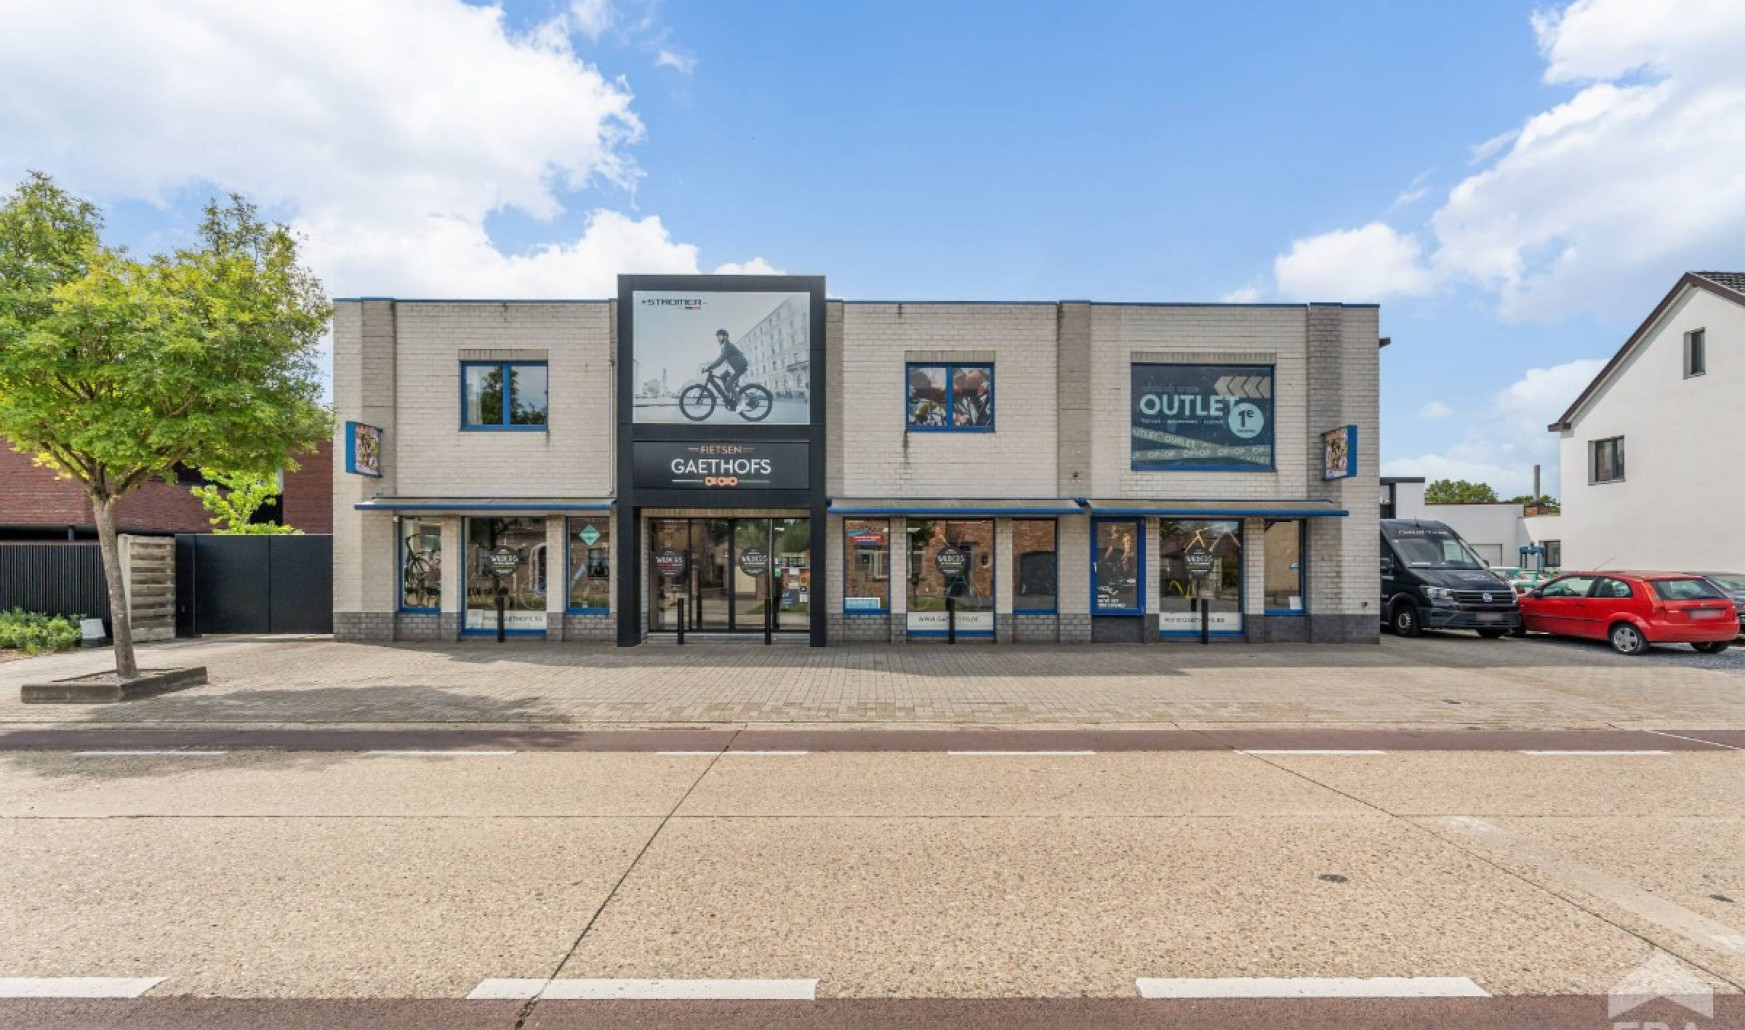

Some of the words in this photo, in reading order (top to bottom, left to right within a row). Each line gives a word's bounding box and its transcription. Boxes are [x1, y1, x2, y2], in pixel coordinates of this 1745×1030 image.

[1139, 393, 1239, 416] OUTLET
[700, 446, 742, 455] FIETSEN
[671, 458, 772, 475] GAETHOFS
